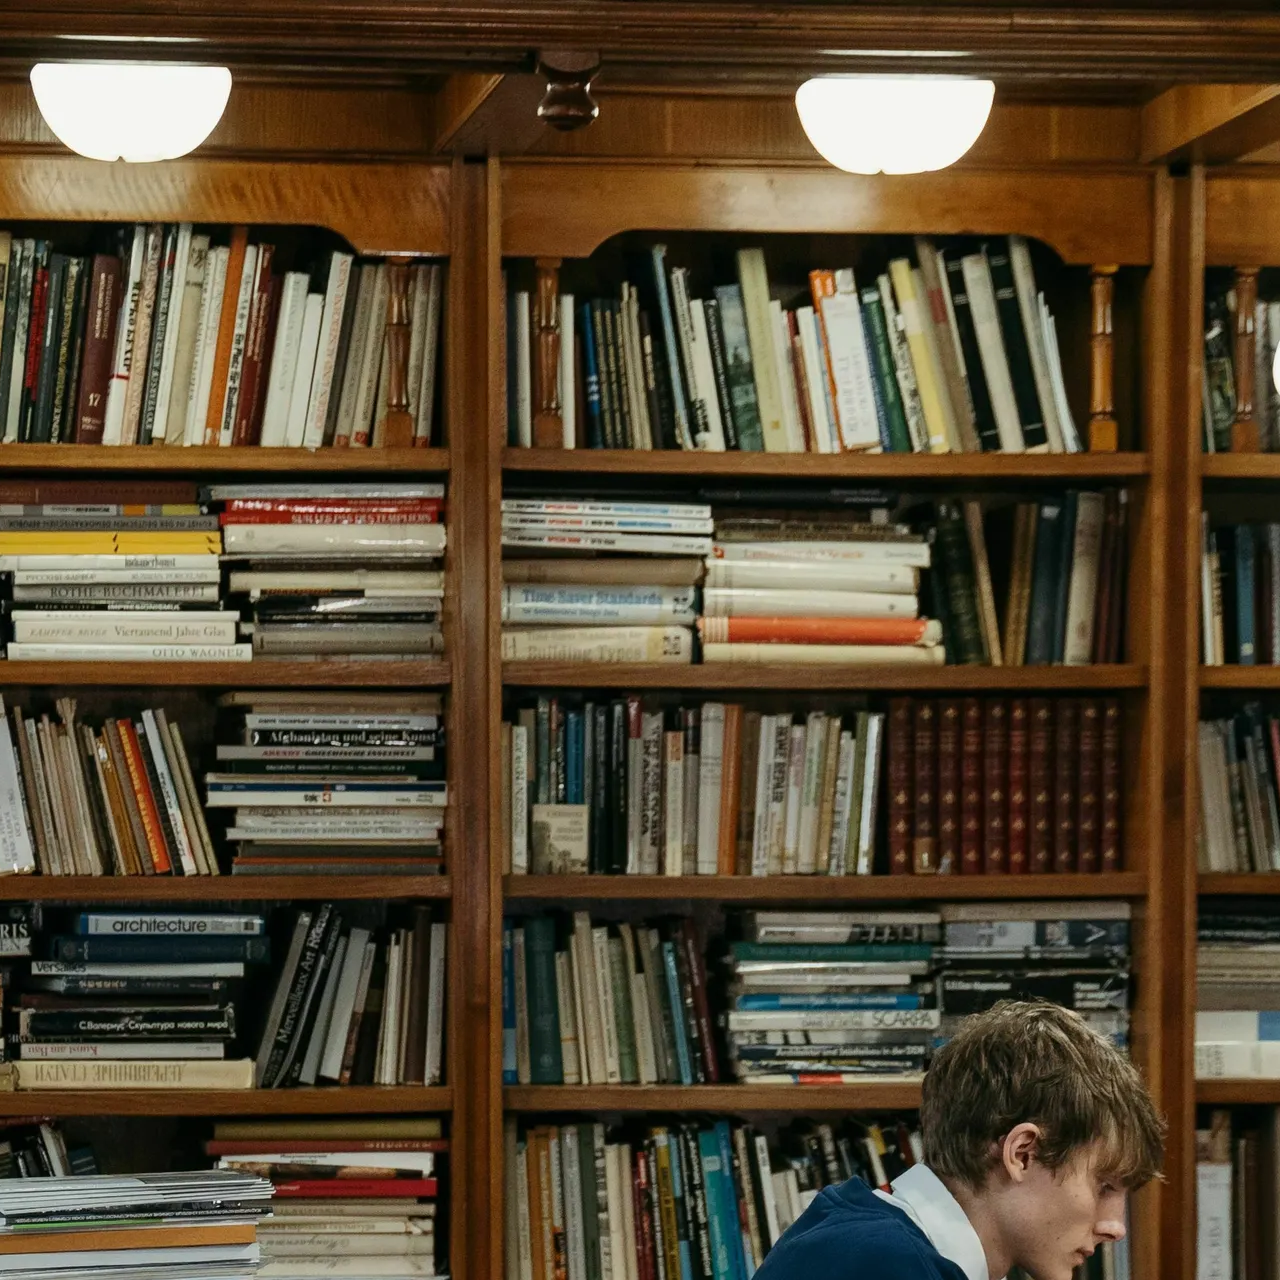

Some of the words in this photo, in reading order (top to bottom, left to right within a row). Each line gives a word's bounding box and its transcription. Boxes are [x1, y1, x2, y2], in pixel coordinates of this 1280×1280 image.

[188, 520, 213, 528] KUNST
[50, 585, 97, 598] ROTHE
[103, 584, 205, 598] BUCHMALEREI
[114, 625, 172, 637] Viertausend
[175, 627, 201, 640] Jahre
[203, 625, 226, 637] Glas
[152, 648, 187, 658] OTTO
[190, 647, 245, 659] WAGNER
[111, 917, 208, 934] architecture
[276, 968, 309, 1043] Merveilleux
[301, 951, 317, 971] Art
[177, 1021, 205, 1030] нового
[206, 1021, 229, 1030] мира
[871, 1010, 935, 1029] SCARPA
[34, 1063, 87, 1082] СТАТУИ
[92, 1063, 187, 1082] ДЕРЕВЯННЫЕ
